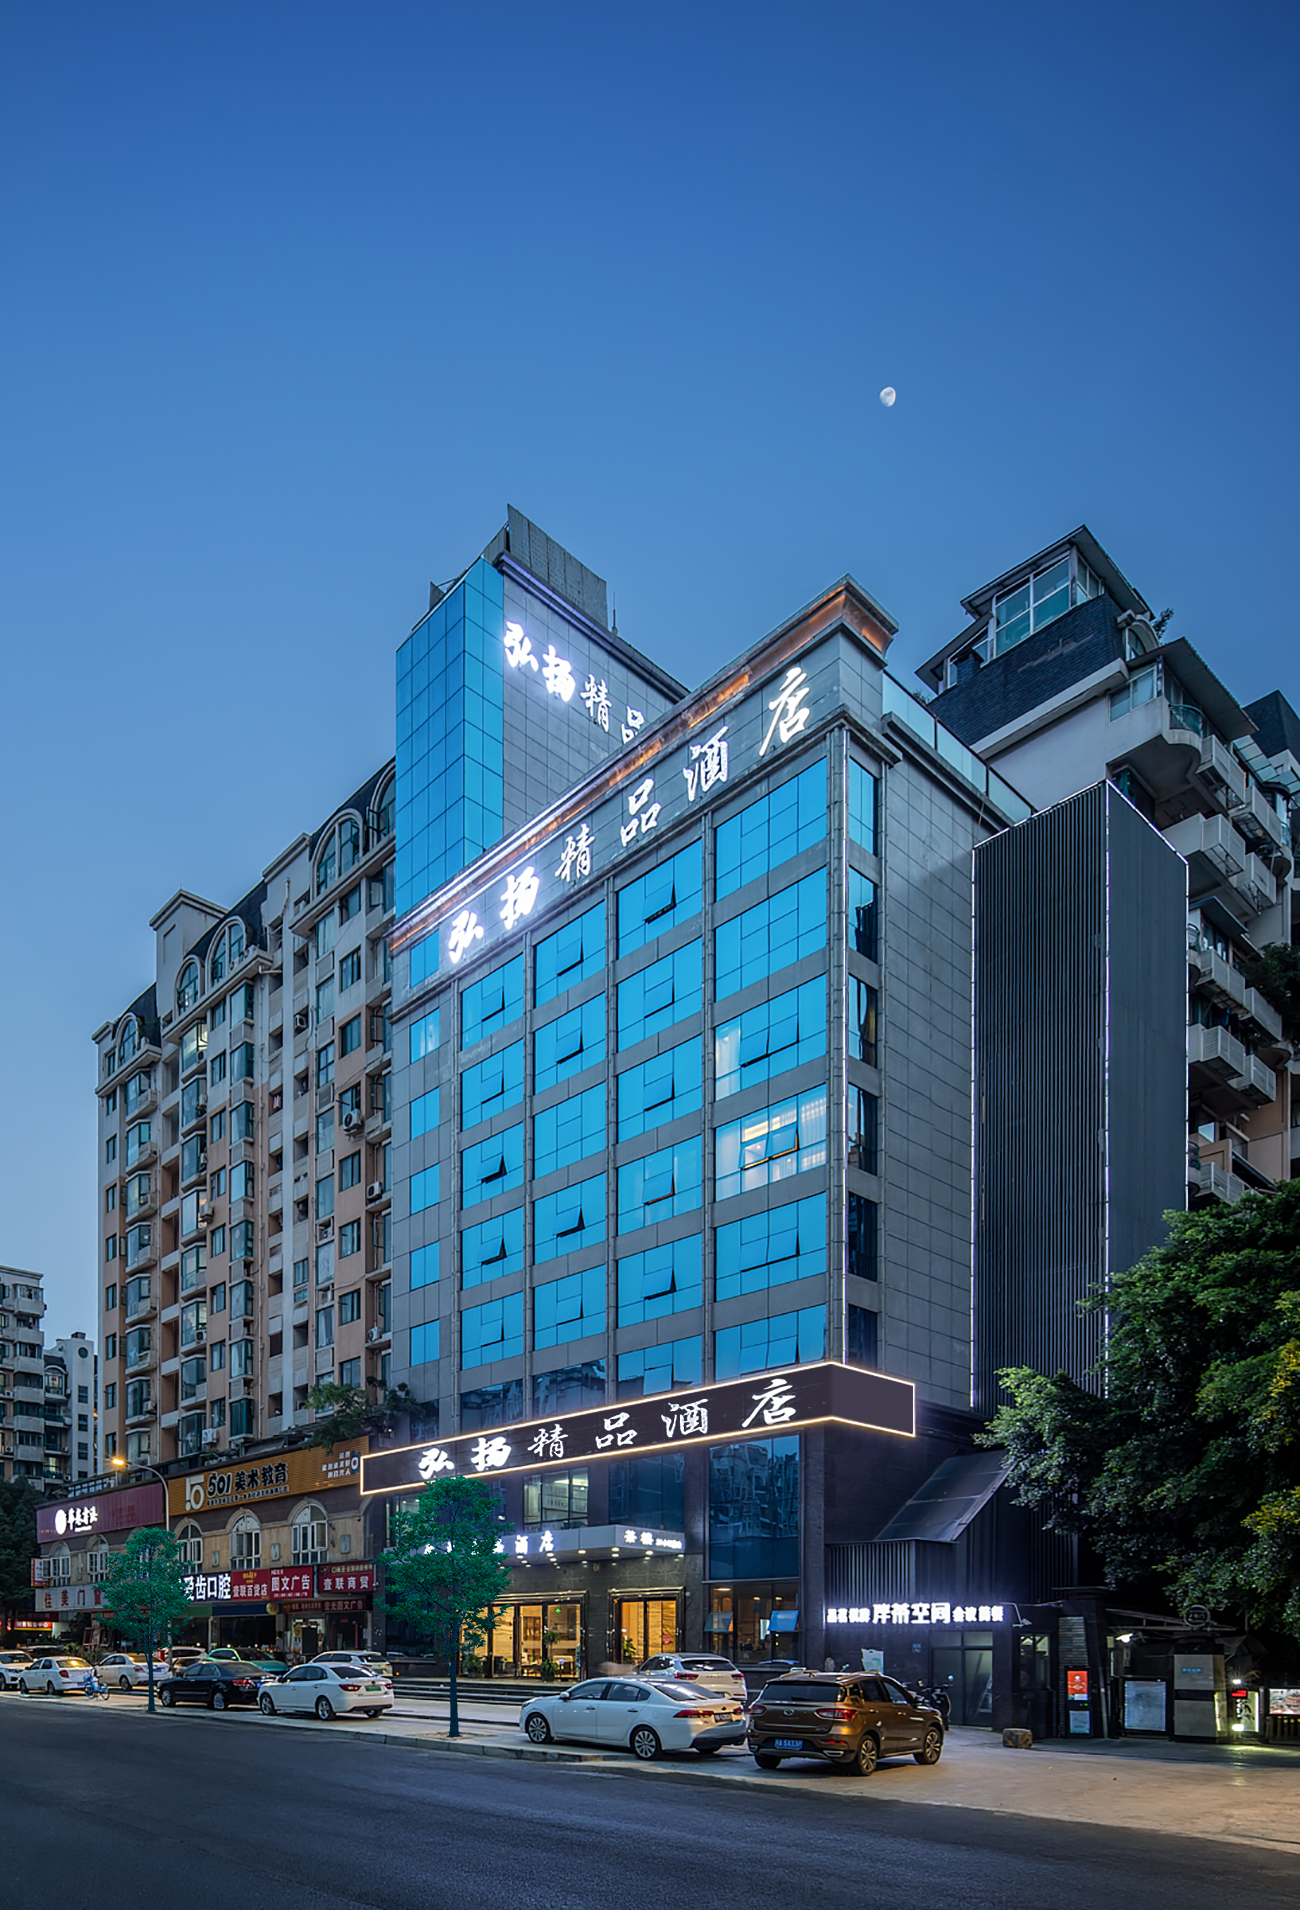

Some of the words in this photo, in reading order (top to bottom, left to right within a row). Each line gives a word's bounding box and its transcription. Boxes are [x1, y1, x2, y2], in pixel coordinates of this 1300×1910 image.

[447, 667, 811, 963] 弘扬精品酒店
[418, 1379, 797, 1480] 弘扬精品酒店
[178, 1573, 231, 1602] 爱齿口腔
[233, 1583, 268, 1599] 壹联百货店
[271, 1574, 310, 1592] 图文广告
[323, 1575, 369, 1591] 壹联商贸
